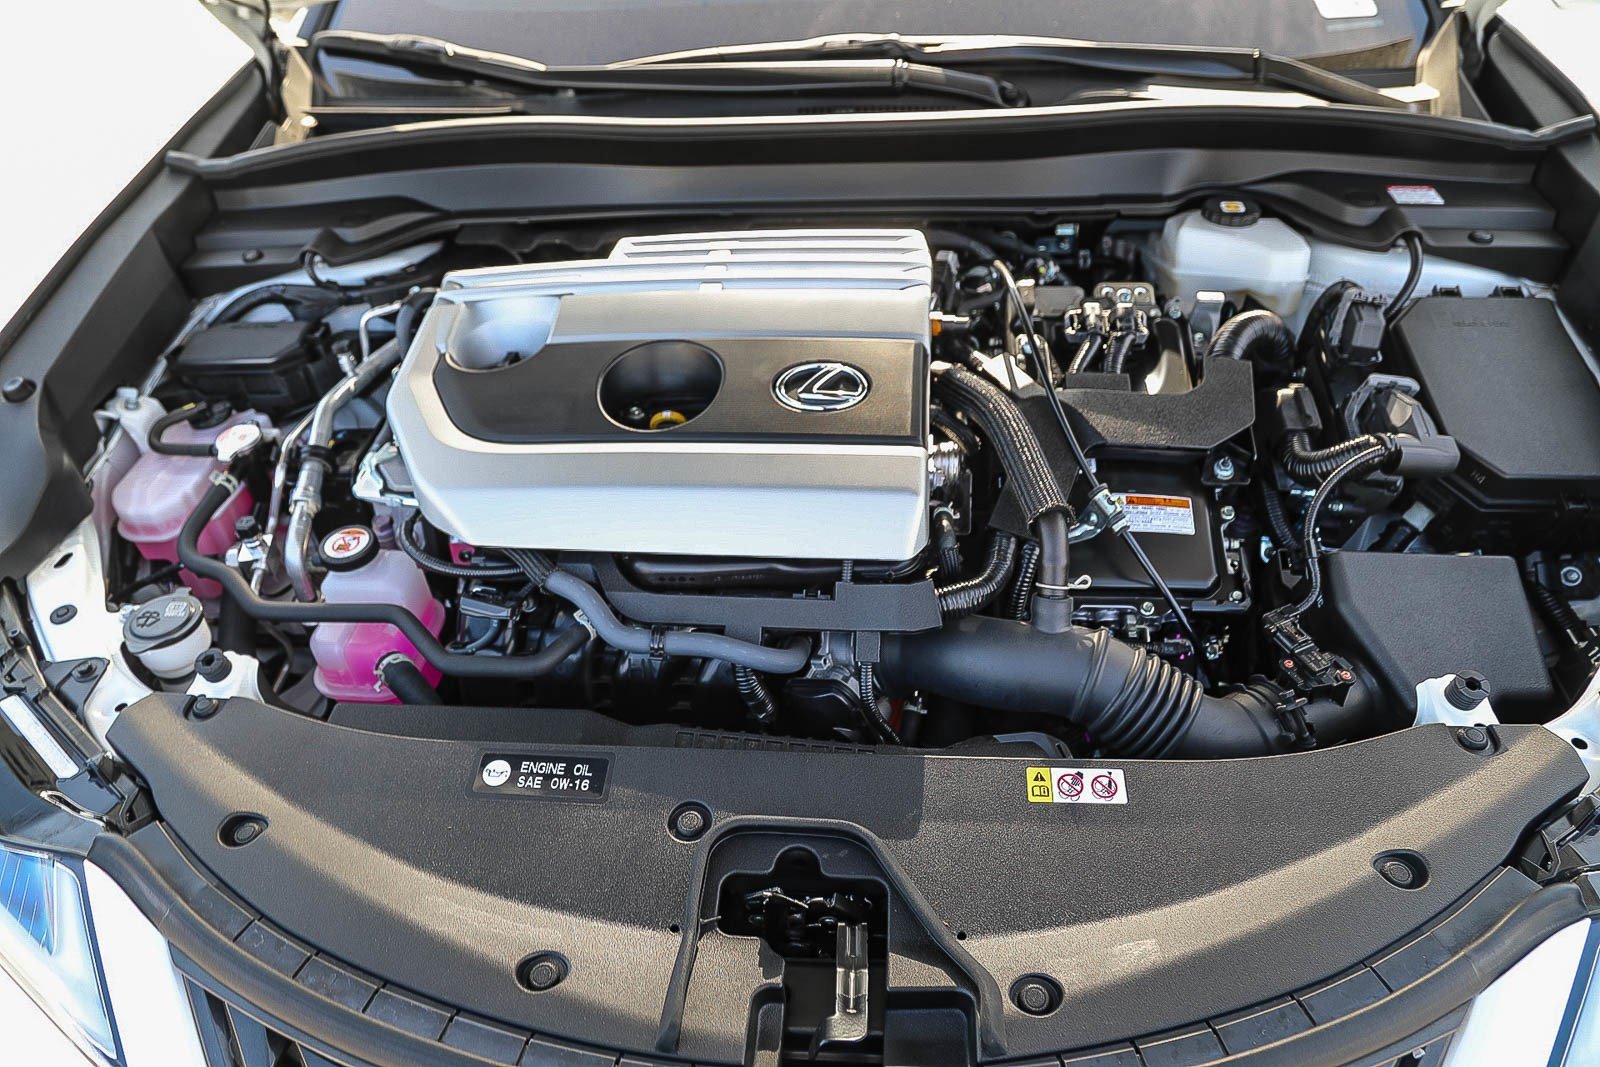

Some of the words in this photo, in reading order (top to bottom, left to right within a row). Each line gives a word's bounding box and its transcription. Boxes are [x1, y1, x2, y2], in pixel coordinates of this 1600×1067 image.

[520, 761, 566, 775] ENGINE
[573, 764, 593, 777] OIL
[516, 775, 543, 789] SAE
[550, 777, 590, 791] 0W-16
